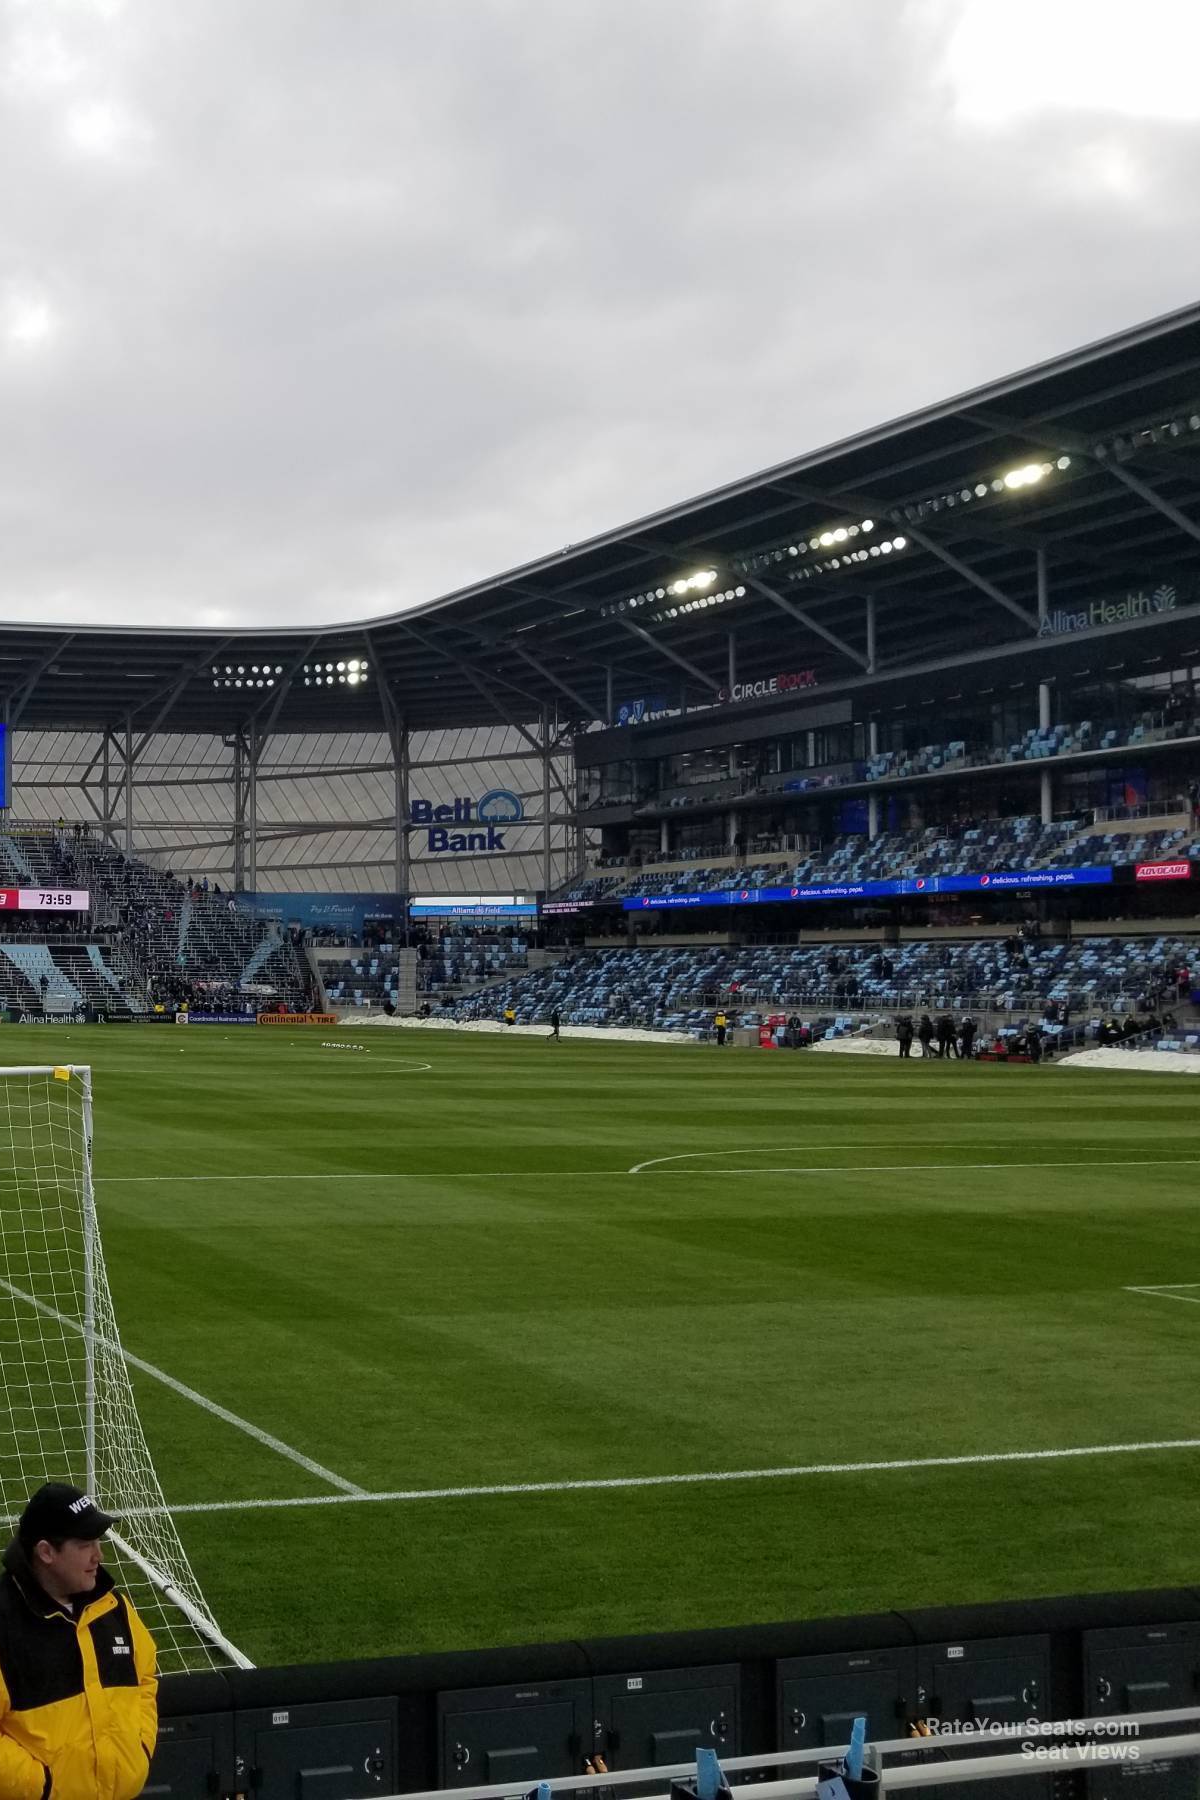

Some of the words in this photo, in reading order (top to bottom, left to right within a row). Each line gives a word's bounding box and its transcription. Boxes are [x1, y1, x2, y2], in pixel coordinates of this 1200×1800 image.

[1038, 611, 1088, 634] Allina
[1089, 592, 1150, 626] Health
[411, 797, 471, 823] Bell
[428, 827, 506, 852] Bank
[1137, 865, 1189, 876] ADVOCARE
[39, 894, 72, 905] 73:59
[19, 1013, 45, 1024] Allina
[45, 1013, 74, 1024] Health
[260, 1014, 307, 1024] Continental
